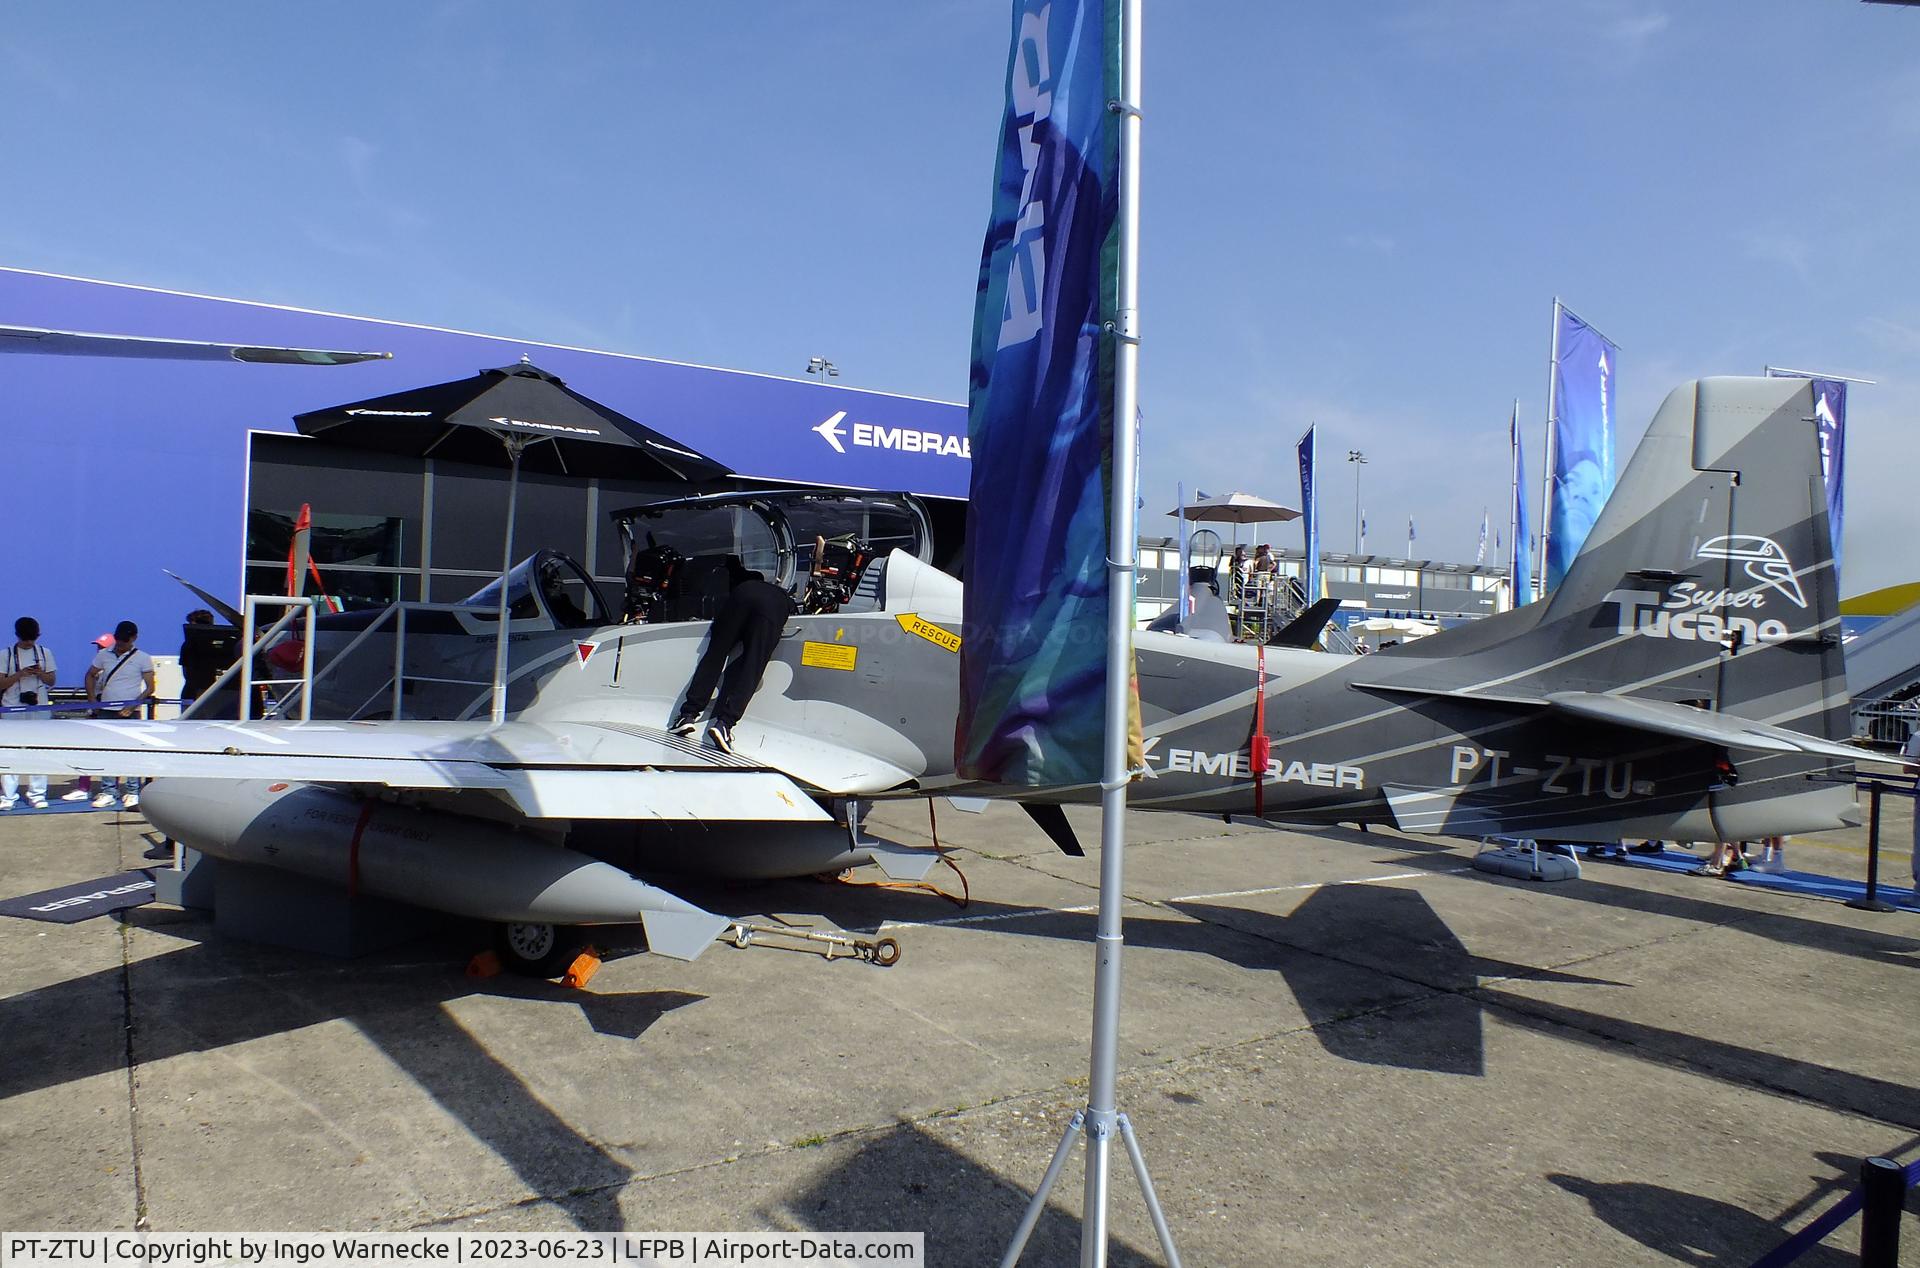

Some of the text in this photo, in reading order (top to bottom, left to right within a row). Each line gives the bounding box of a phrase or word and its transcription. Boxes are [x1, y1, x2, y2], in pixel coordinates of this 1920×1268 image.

[1602, 589, 1788, 645] Tucano
[1662, 582, 1767, 613] Super
[912, 620, 958, 649] RESCUE
[1451, 745, 1633, 799] PT-ZTU
